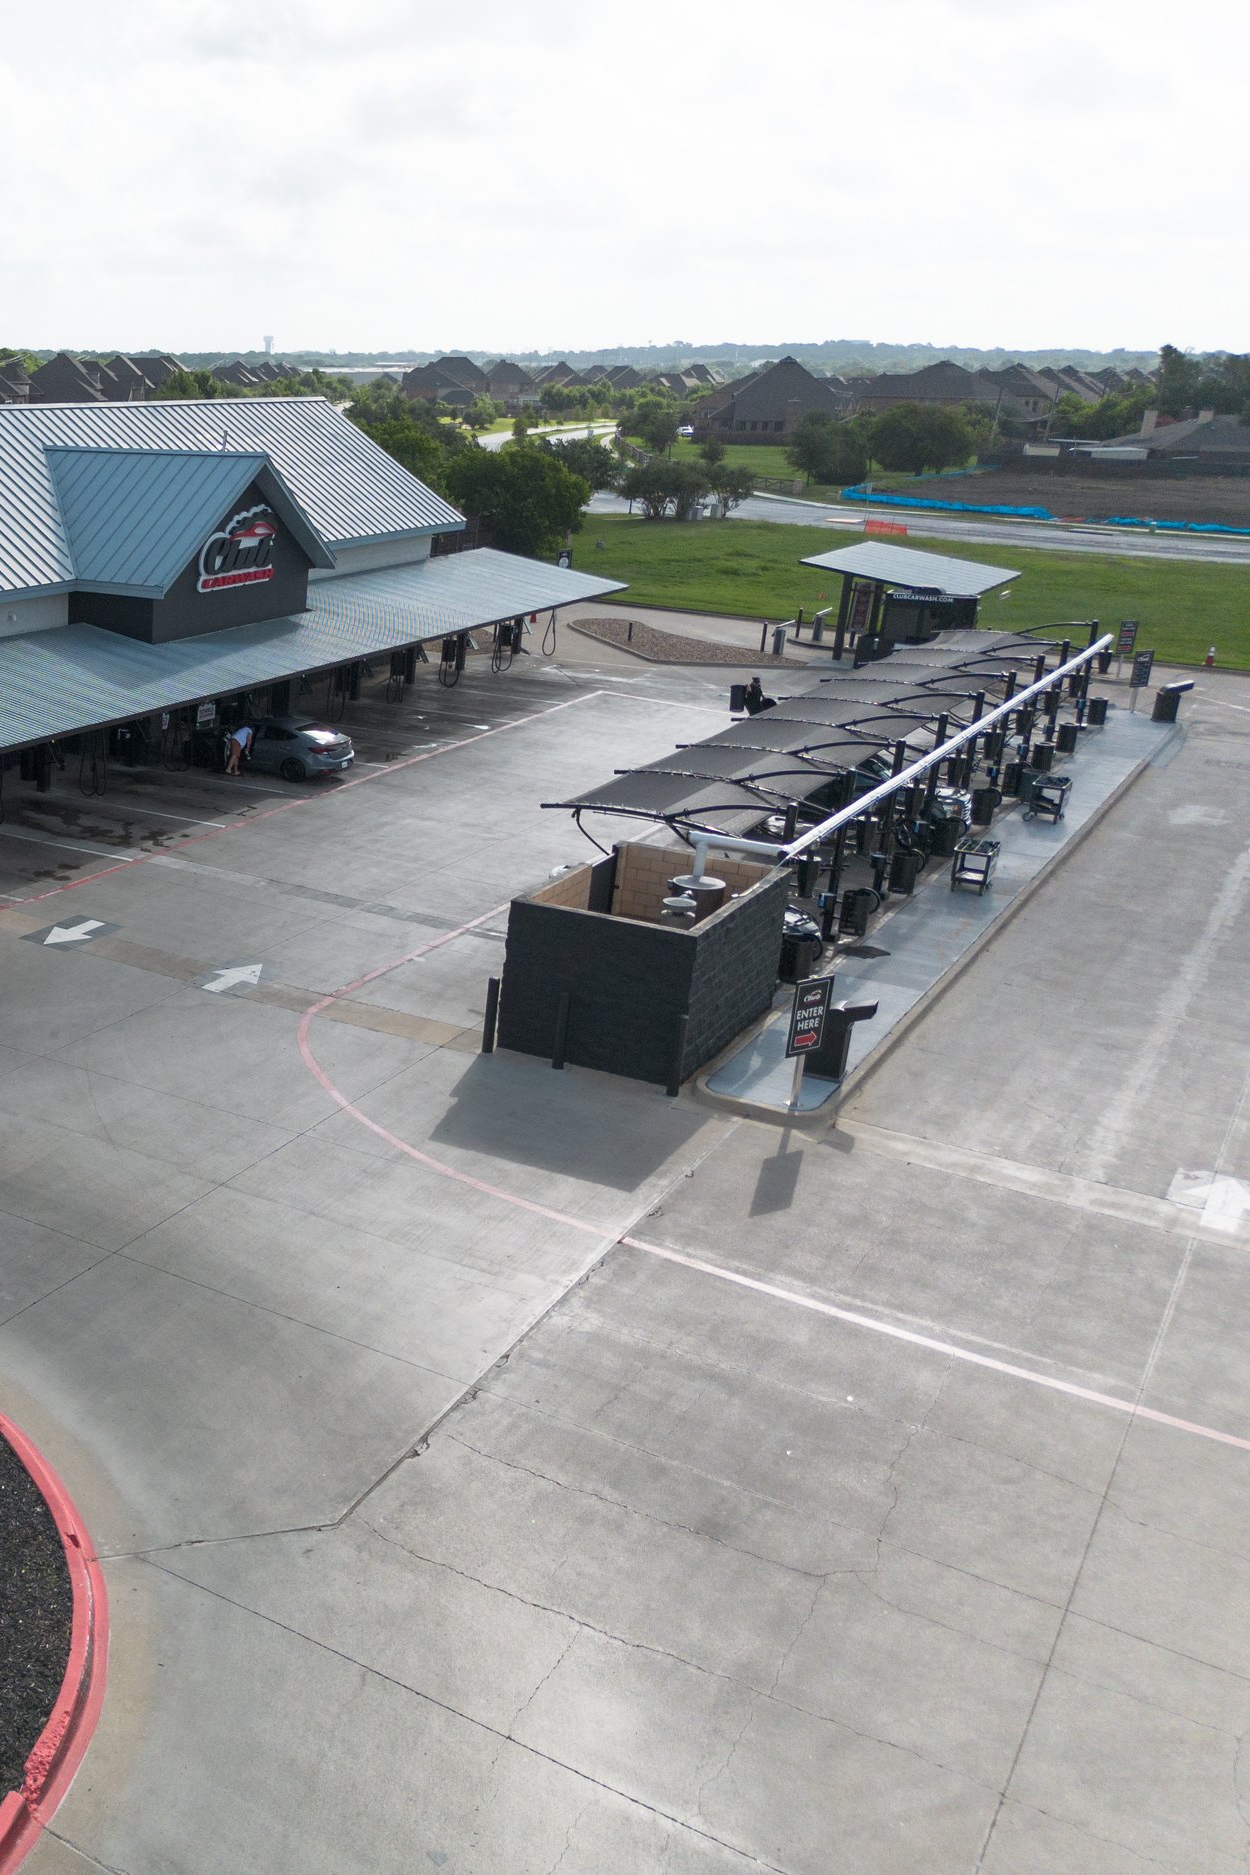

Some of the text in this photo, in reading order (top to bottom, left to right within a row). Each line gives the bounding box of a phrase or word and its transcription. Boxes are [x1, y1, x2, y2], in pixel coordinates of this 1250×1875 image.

[202, 533, 276, 577] Club
[796, 1005, 824, 1020] ENTER
[797, 1017, 820, 1031] HERE
